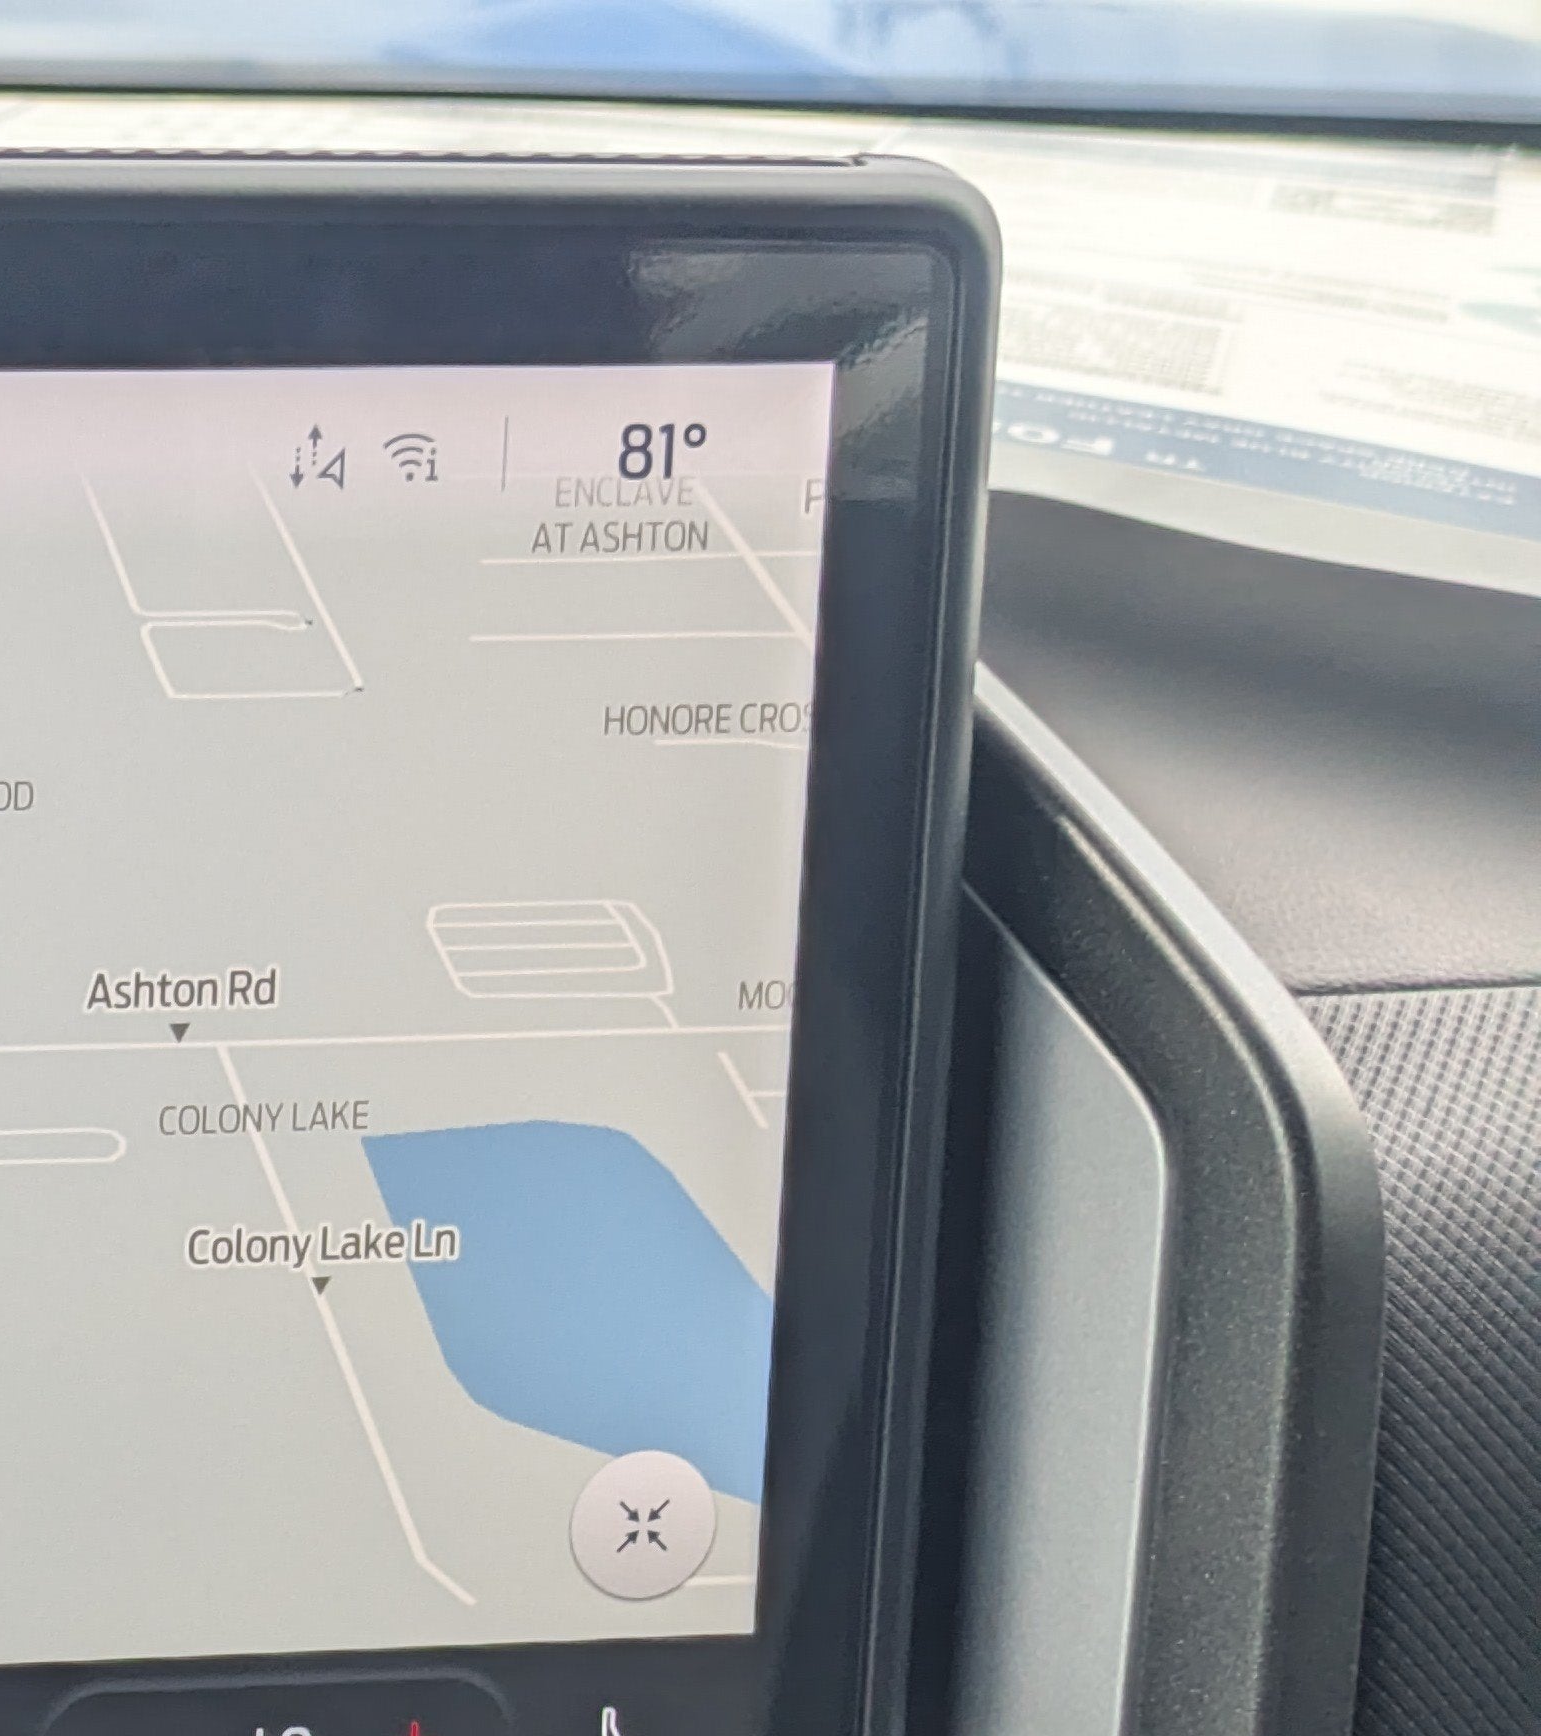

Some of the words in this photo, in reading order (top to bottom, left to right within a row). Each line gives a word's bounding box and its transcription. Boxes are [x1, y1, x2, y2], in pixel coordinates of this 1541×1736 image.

[618, 422, 707, 481] 81°
[555, 476, 696, 508] ENCLAVE
[531, 522, 570, 553] AT
[579, 520, 708, 553] ASHTON
[604, 703, 733, 736] HONORE
[87, 972, 218, 1009] Ashton
[228, 969, 276, 1005] Rd
[159, 1102, 284, 1136] COLONY
[292, 1100, 370, 1132] LAKE
[188, 1227, 312, 1268] Colony
[320, 1224, 405, 1261] Lake
[414, 1223, 456, 1258] Ln
